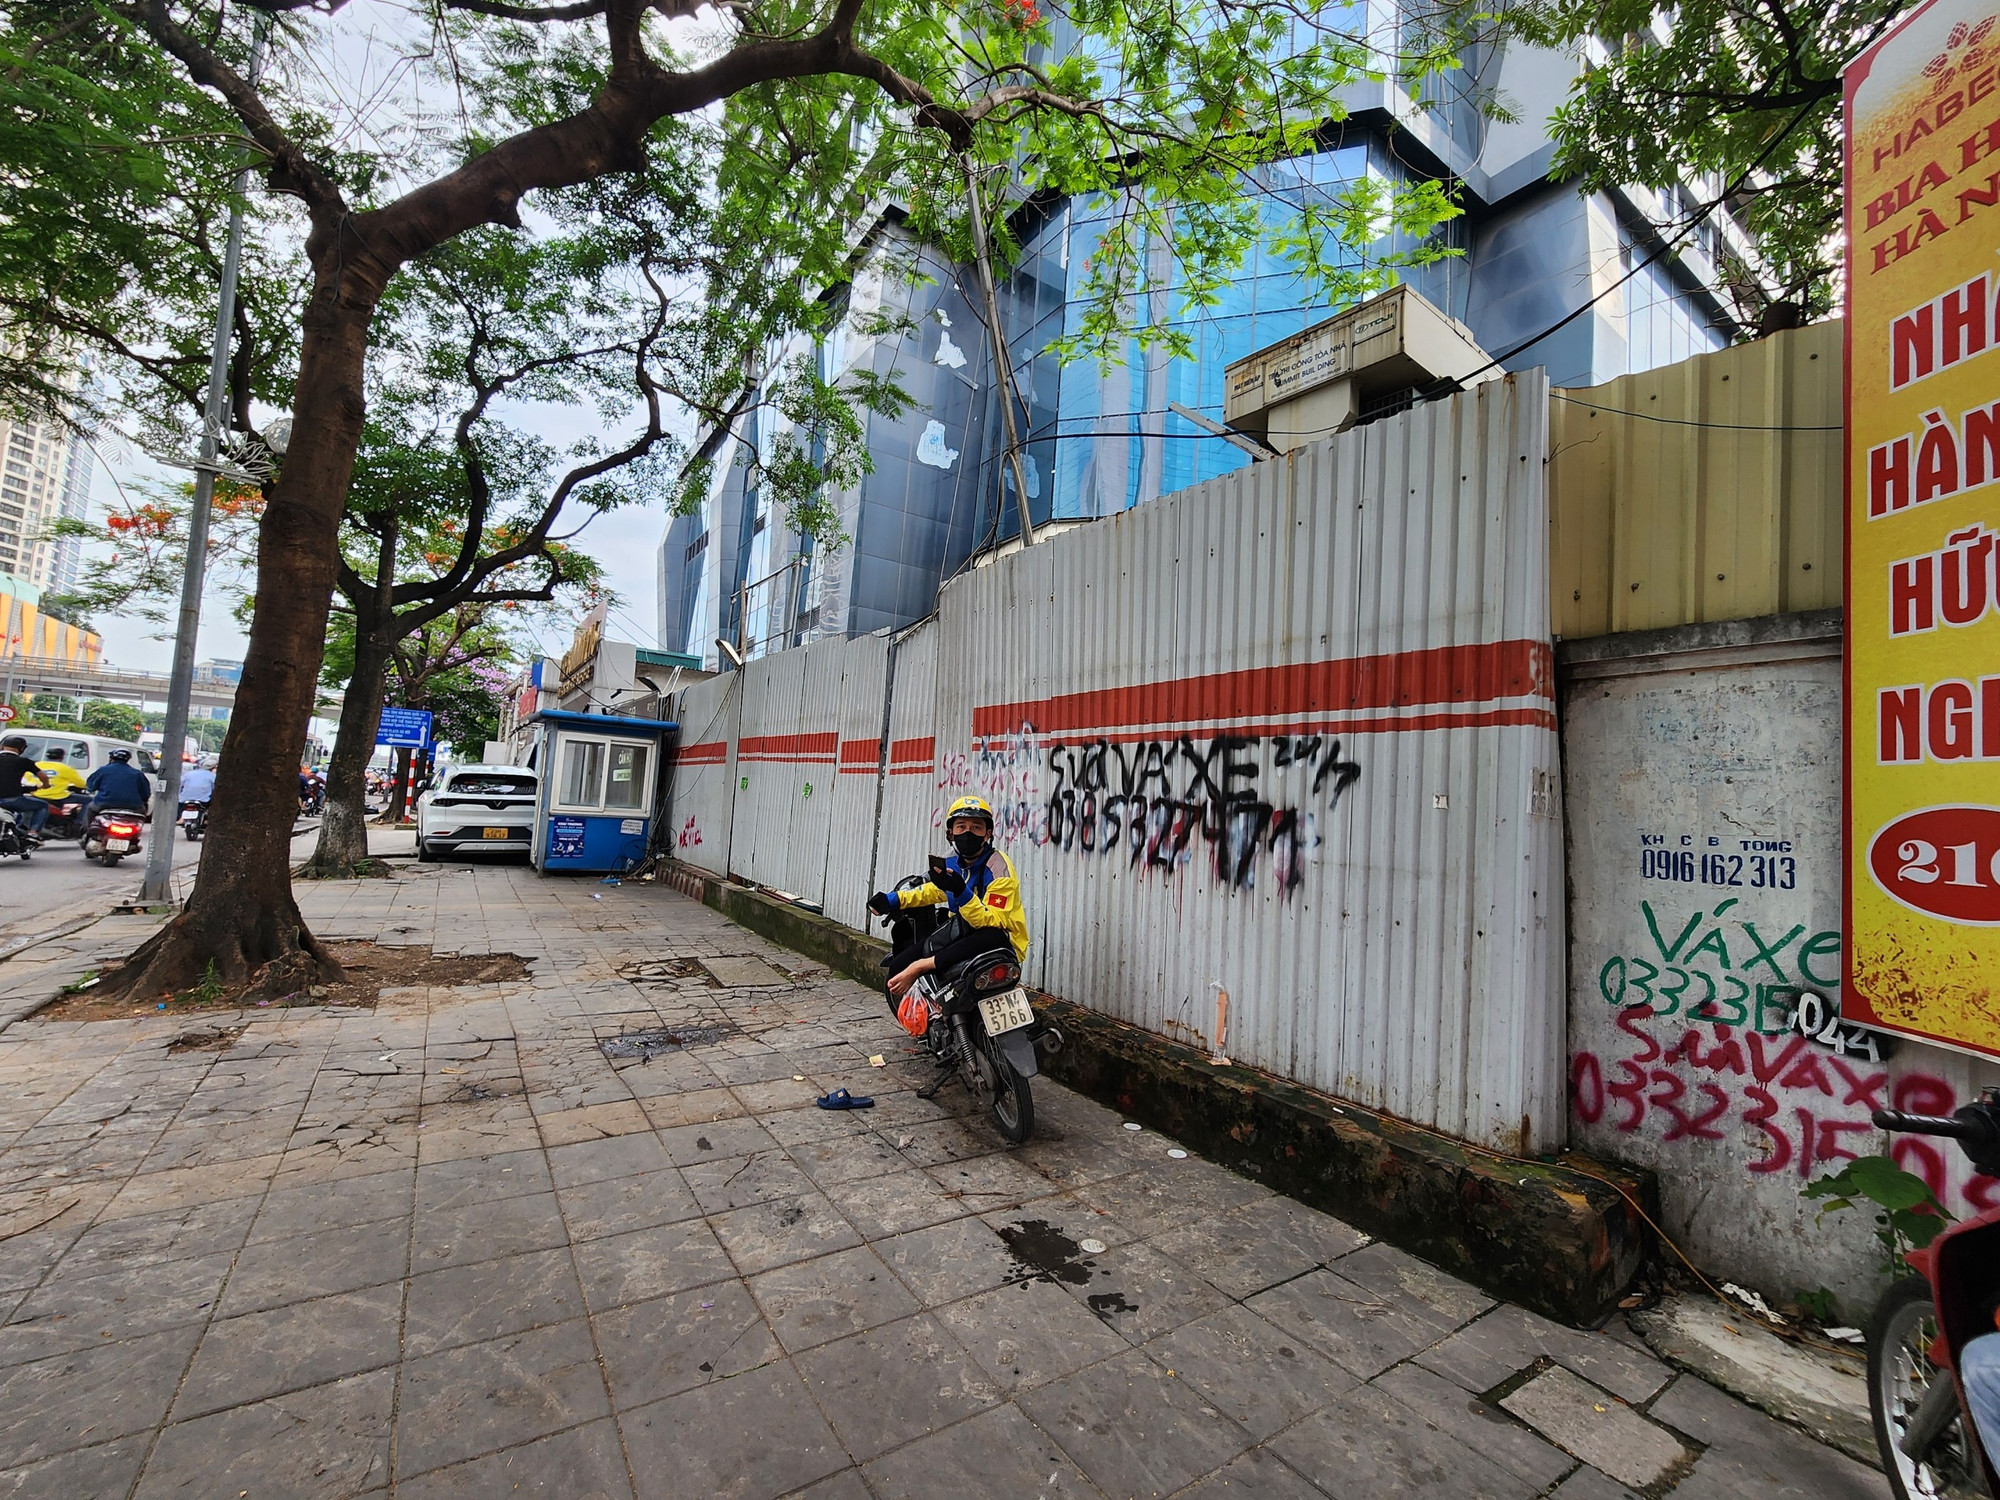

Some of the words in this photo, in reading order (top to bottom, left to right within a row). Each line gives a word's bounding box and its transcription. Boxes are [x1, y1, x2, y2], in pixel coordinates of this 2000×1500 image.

[1873, 63, 2000, 173] HABE
[1863, 161, 1952, 233] BIA
[1871, 208, 1950, 275] HÀ
[1291, 356, 1313, 371] CÔNG
[1314, 350, 1329, 361] TÒA
[1891, 271, 2000, 391] NH
[1275, 372, 1300, 388] UMMIT
[1891, 525, 2000, 635] HỮ
[1897, 839, 2000, 888] 21
[990, 1008, 1027, 1032] 5766
